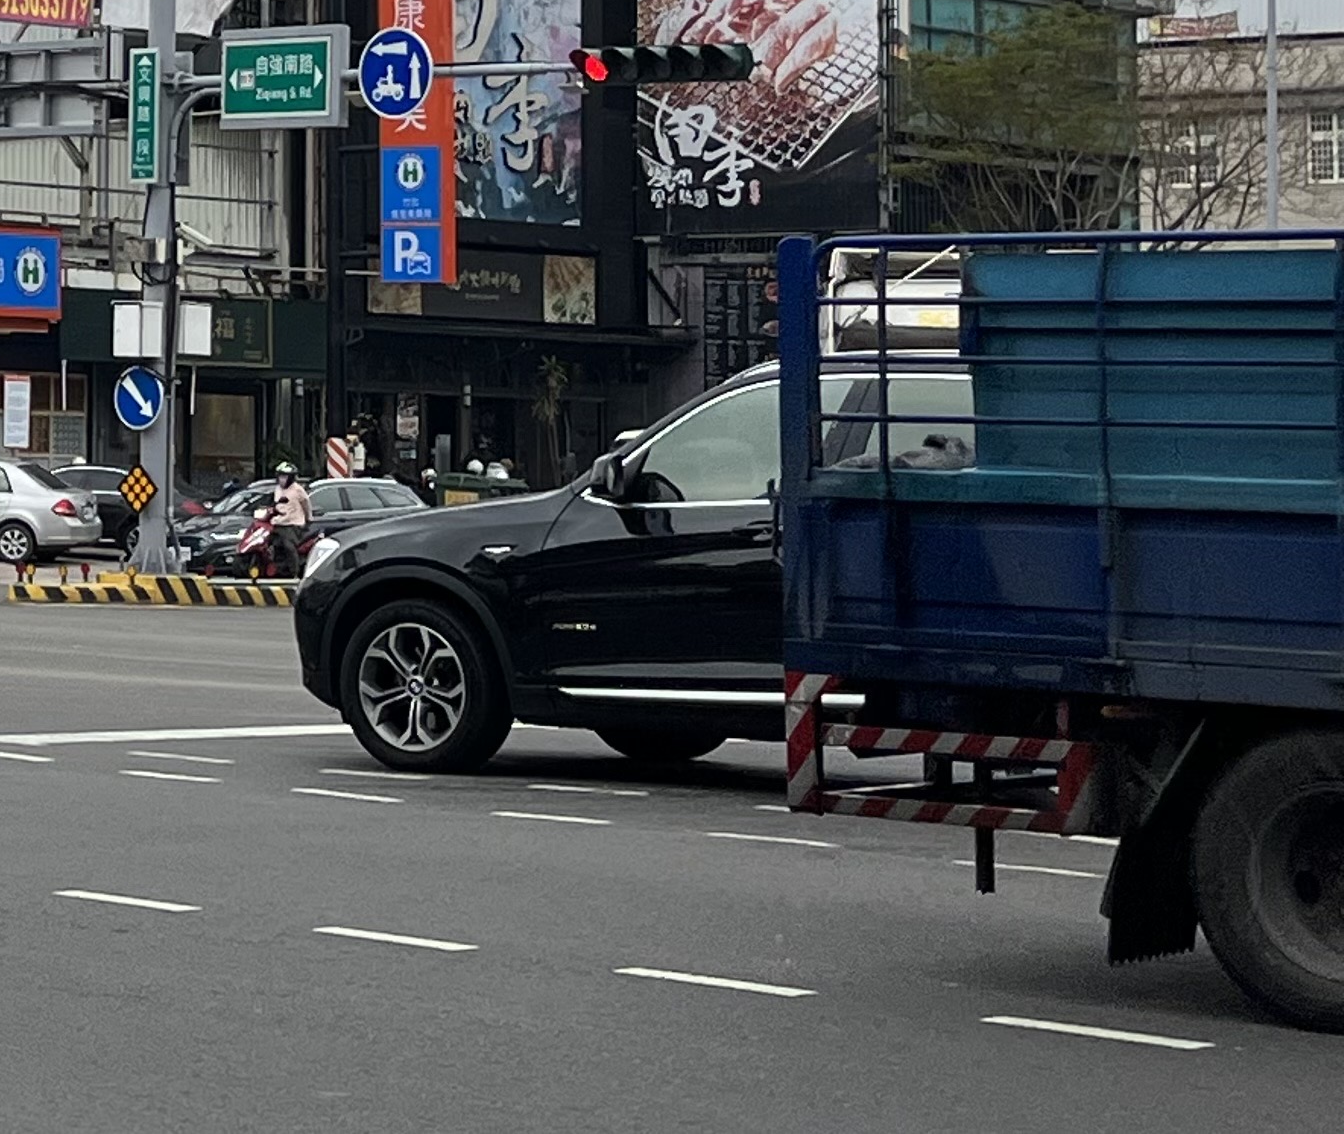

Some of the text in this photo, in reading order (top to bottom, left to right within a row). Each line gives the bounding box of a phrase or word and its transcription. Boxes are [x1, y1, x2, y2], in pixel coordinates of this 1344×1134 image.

[255, 53, 313, 76] 自強南路
[136, 66, 152, 155] 文興路一段
